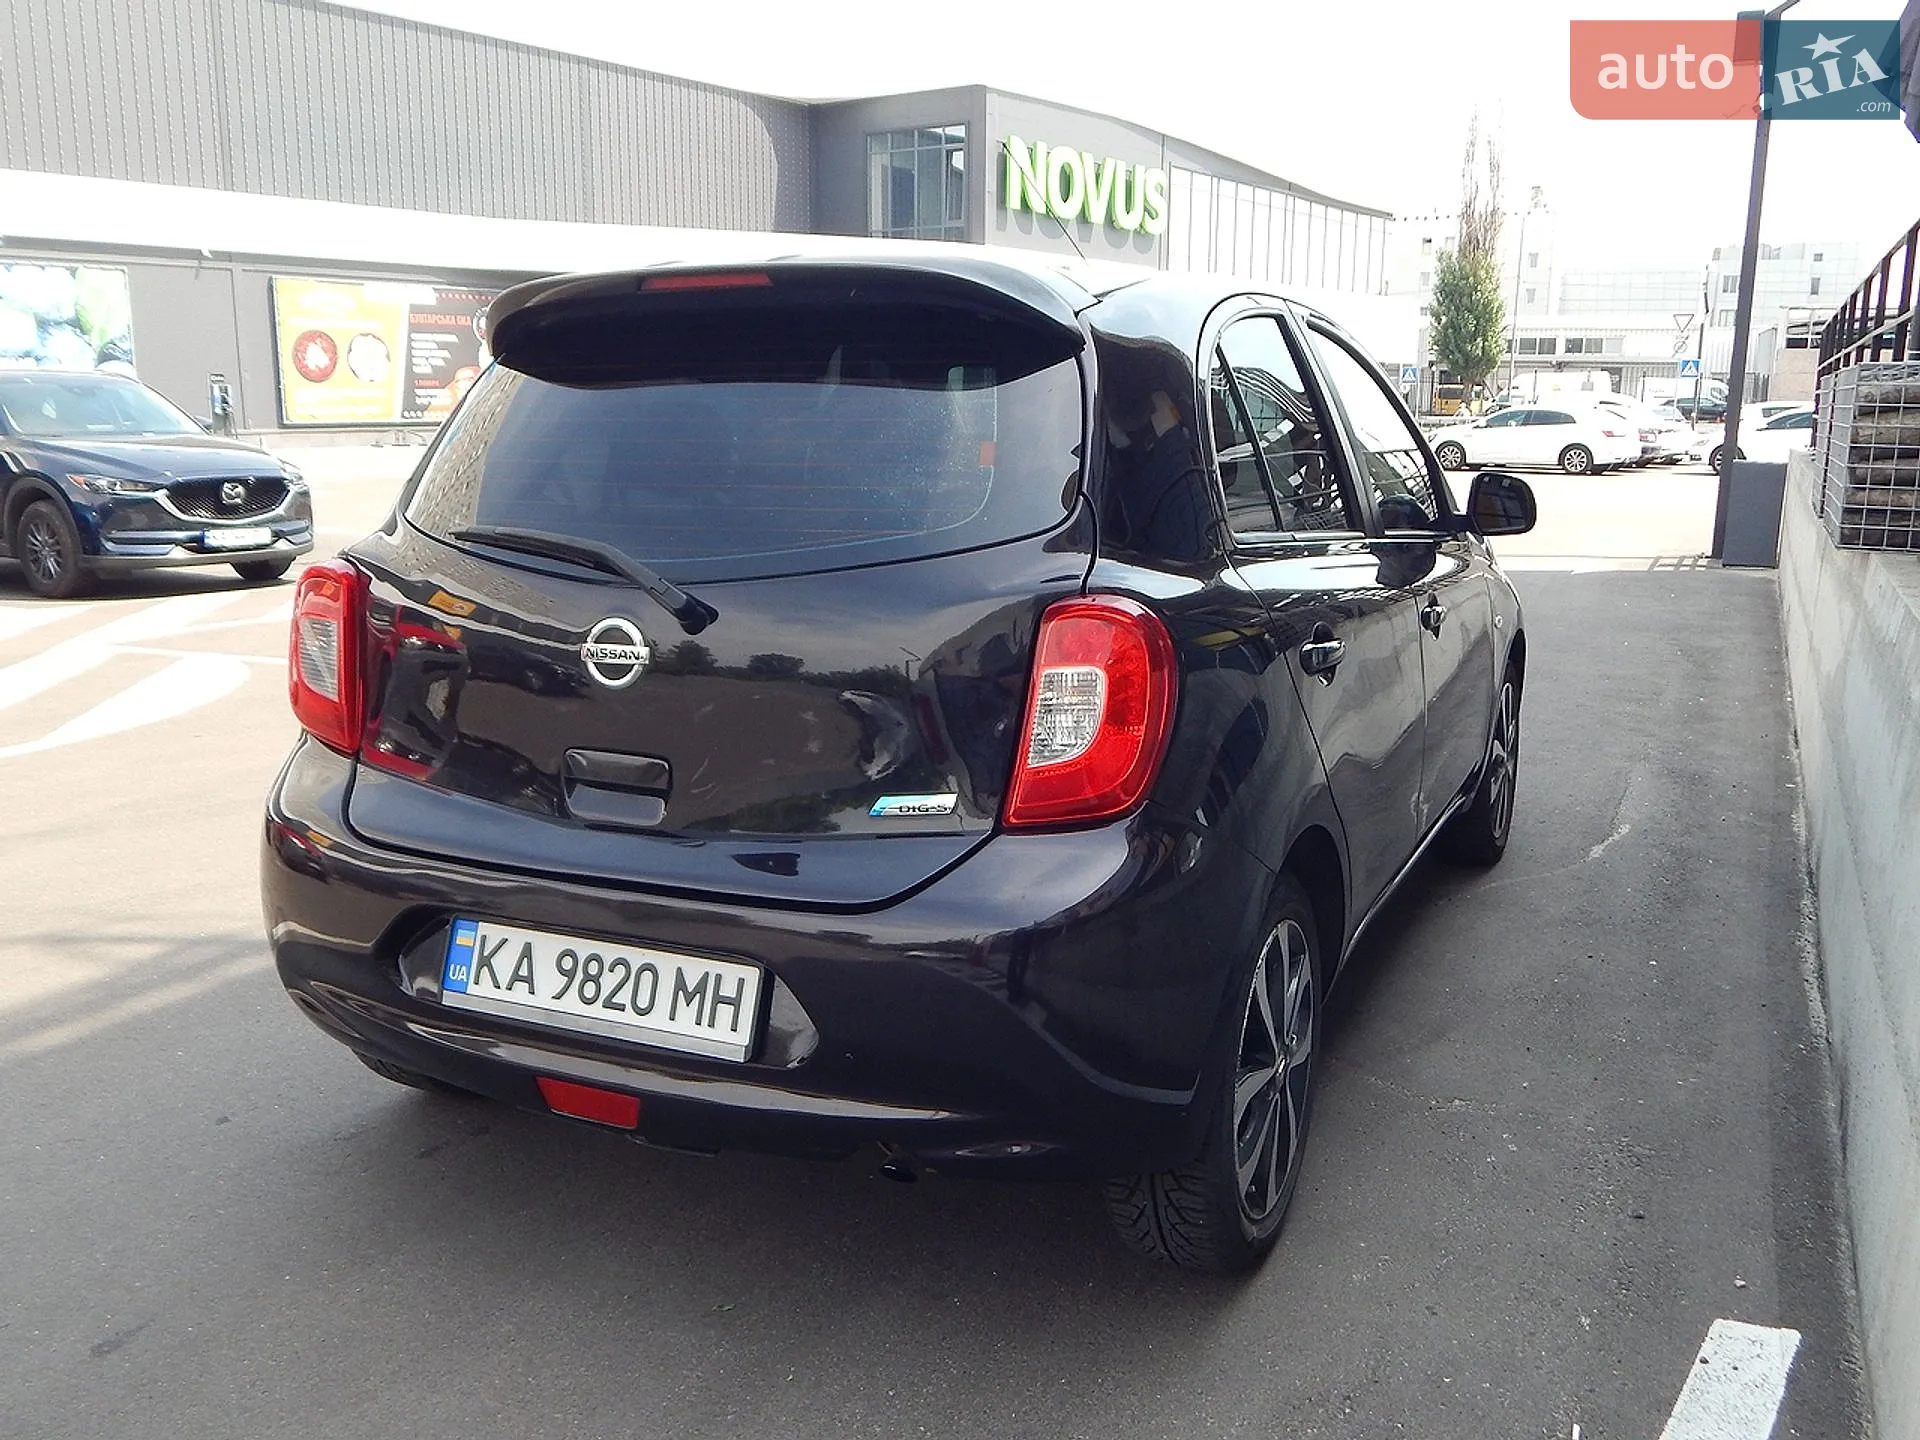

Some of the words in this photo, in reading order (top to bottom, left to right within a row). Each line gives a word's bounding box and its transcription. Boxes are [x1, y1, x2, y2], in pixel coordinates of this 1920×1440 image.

[1004, 134, 1168, 235] NOVUS
[586, 646, 640, 661] NISSAN
[449, 962, 468, 983] UA
[473, 933, 536, 996] KA
[551, 947, 660, 1017] 9820
[668, 965, 745, 1032] MH
